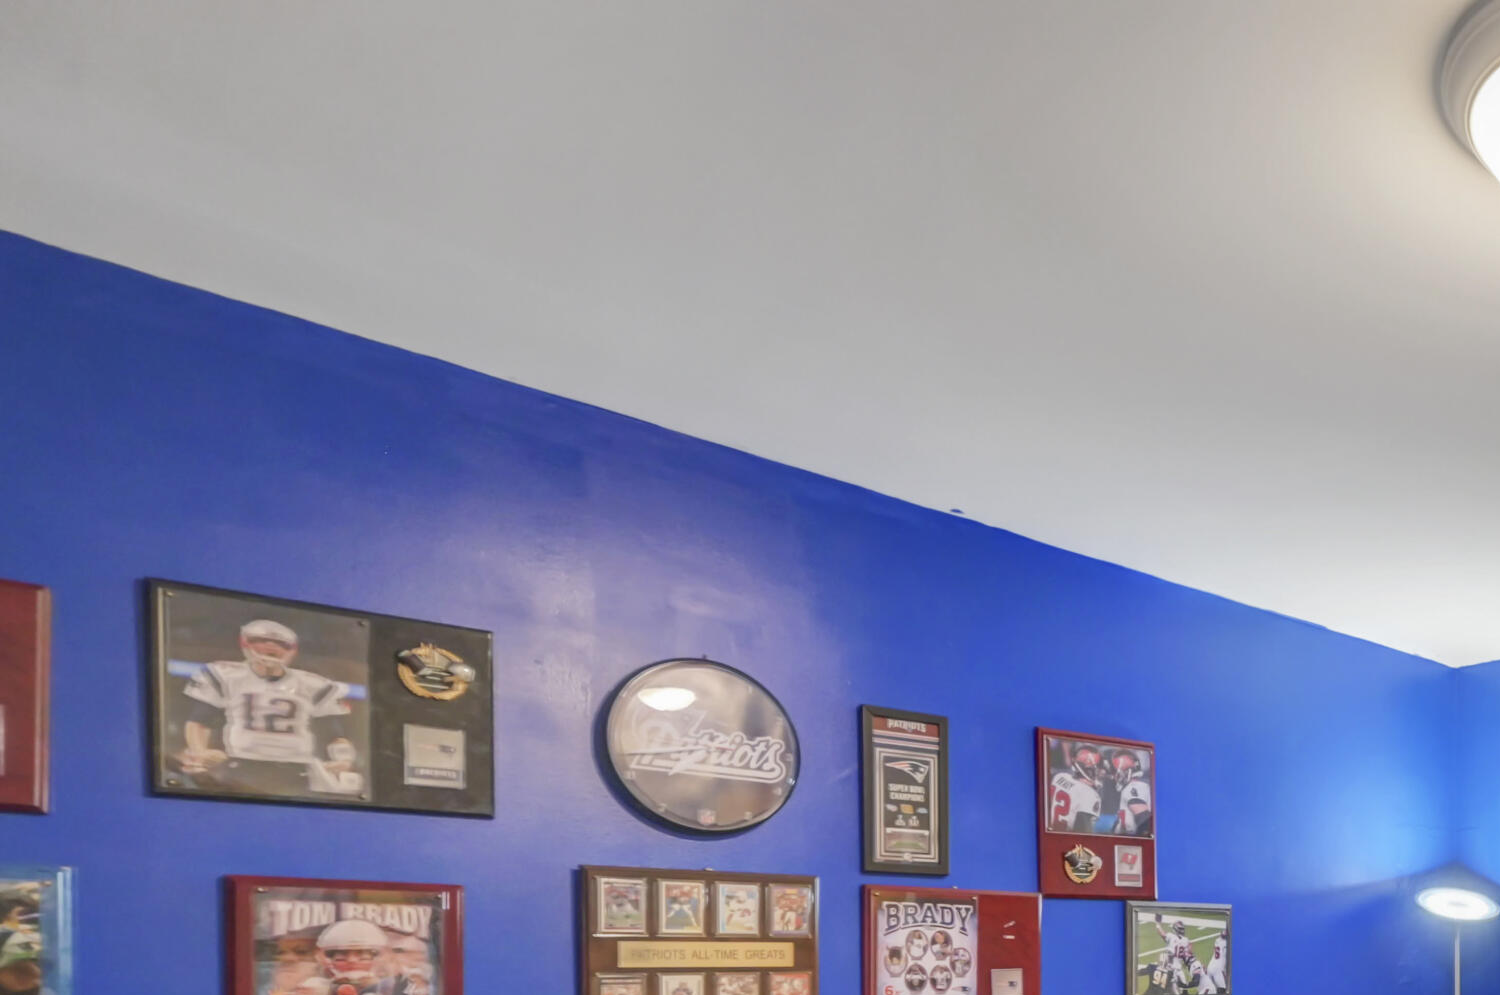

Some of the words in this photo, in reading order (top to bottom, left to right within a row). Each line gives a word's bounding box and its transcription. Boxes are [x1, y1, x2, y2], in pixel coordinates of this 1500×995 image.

[241, 693, 297, 734] 12
[270, 901, 336, 937] TOM
[340, 902, 433, 941] BRADY
[884, 902, 973, 935] BRADY
[631, 948, 687, 961] PATRIOTS
[691, 949, 739, 961] ALL-TIME
[744, 949, 786, 961] GREATS
